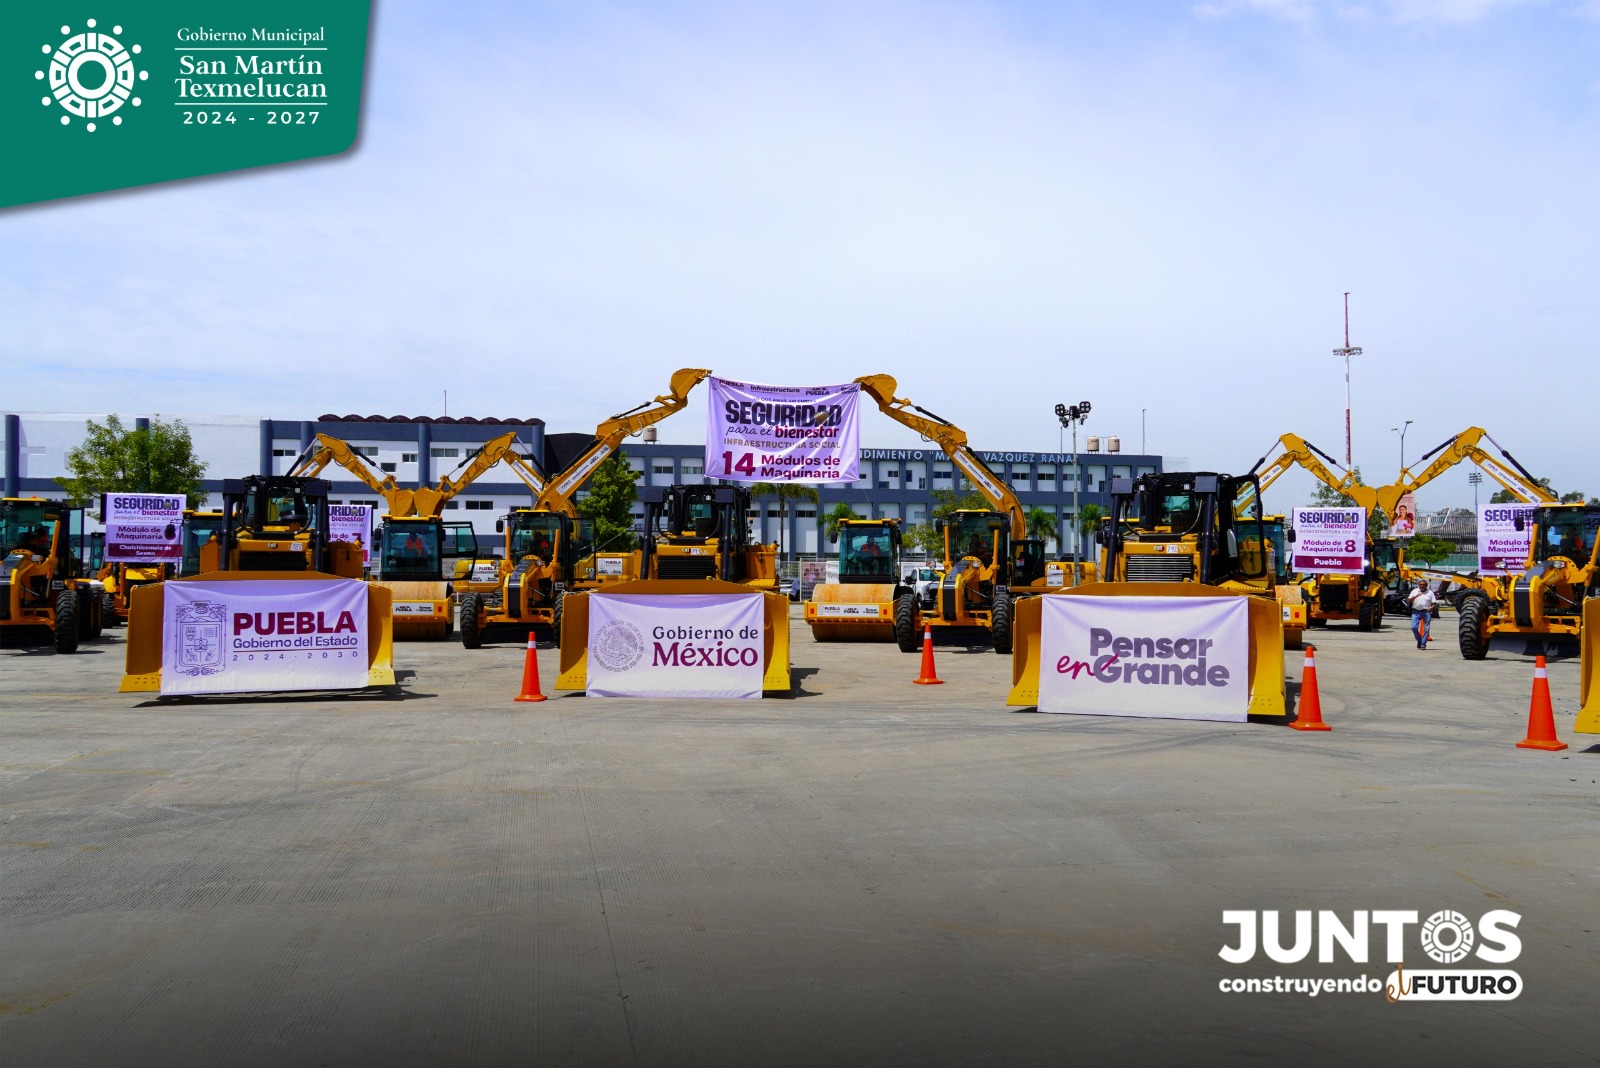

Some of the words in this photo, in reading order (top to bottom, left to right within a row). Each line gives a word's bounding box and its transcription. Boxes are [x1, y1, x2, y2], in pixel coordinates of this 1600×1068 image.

[750, 385, 800, 394] Infraestructura
[726, 426, 757, 436] para
[760, 426, 774, 435] el
[775, 425, 840, 438] bienestar
[723, 450, 756, 476] 14
[761, 454, 821, 466] Módulos
[824, 455, 840, 466] de
[984, 452, 1035, 462] VAZQUEZ
[761, 467, 840, 480] Maquinaria
[1344, 540, 1356, 553] 8
[234, 611, 357, 635] PUEBLA
[652, 626, 734, 640] Gobierno
[739, 626, 758, 640] de
[233, 637, 291, 648] Gobierno
[294, 637, 313, 647] del
[316, 636, 358, 646] Estado
[1090, 628, 1213, 659] Pensar
[652, 641, 758, 667] México
[1057, 653, 1101, 680] en
[1093, 654, 1230, 687] Grande
